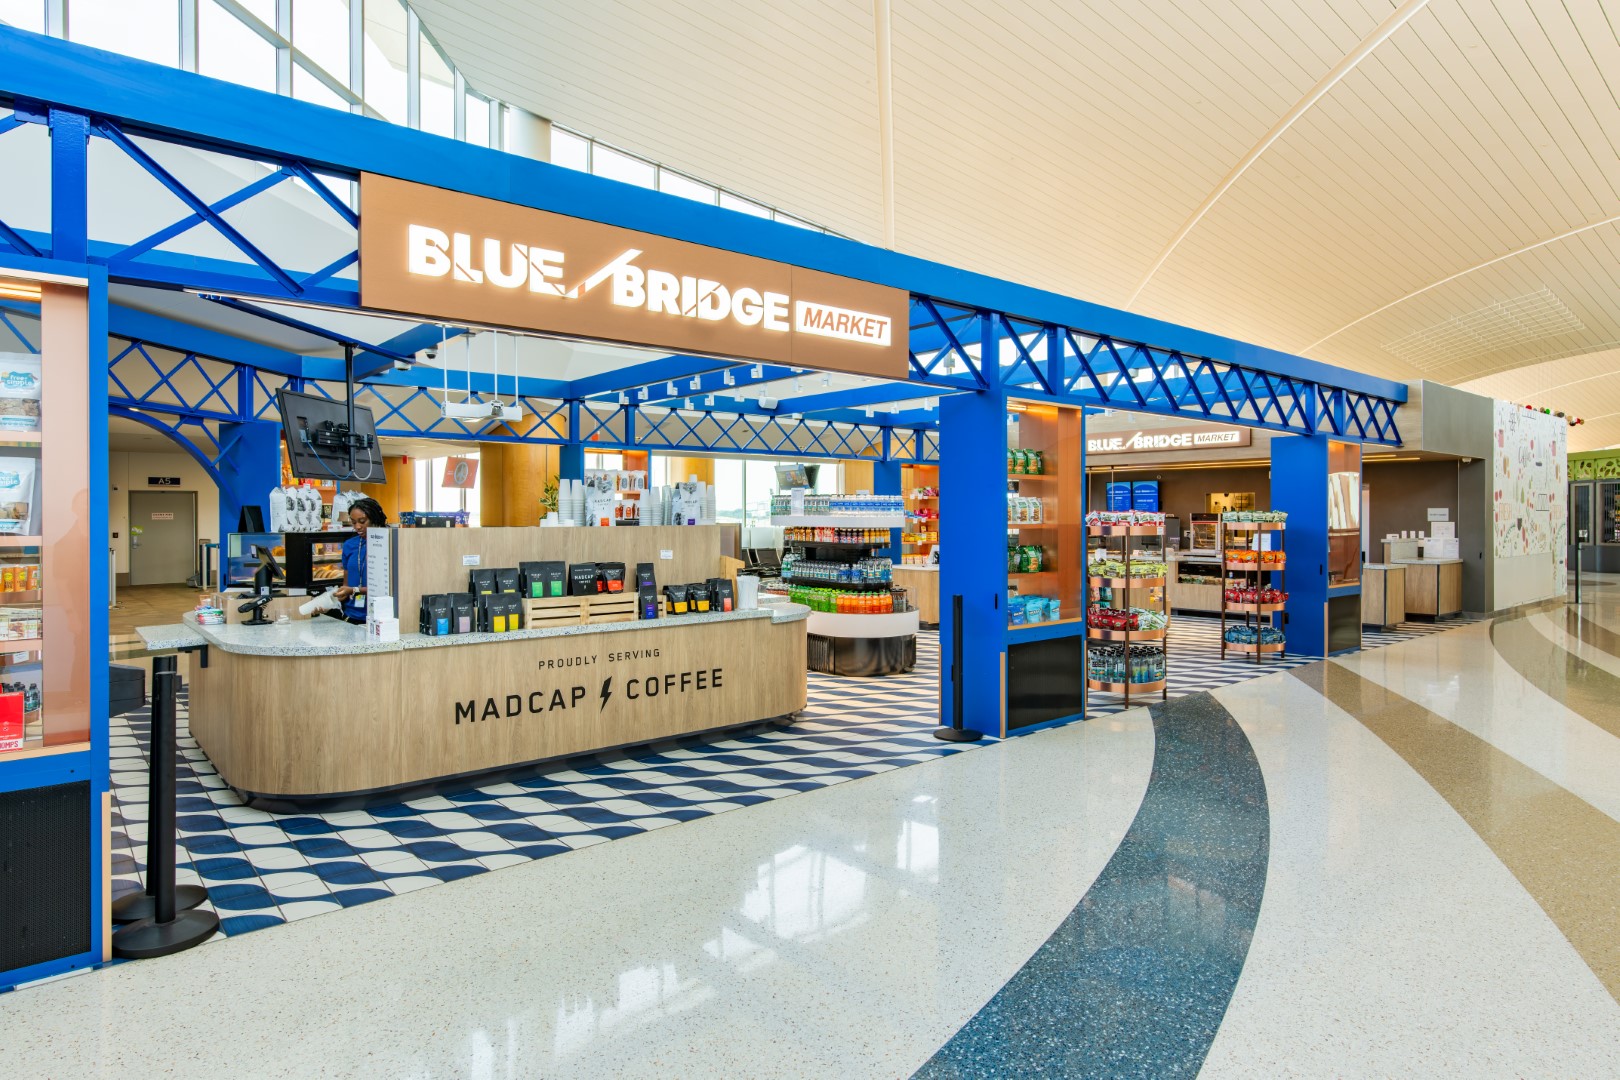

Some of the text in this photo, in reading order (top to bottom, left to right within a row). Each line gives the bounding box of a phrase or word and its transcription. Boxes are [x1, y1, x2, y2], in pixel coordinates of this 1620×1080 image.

[408, 224, 888, 340] BLUE BRIDGE MARKET
[1087, 431, 1236, 452] BLUE BRIDGE MARKET
[158, 477, 171, 485] A5
[538, 648, 661, 670] PROUDLY SERVING
[455, 668, 723, 725] MADCAP COFFEE
